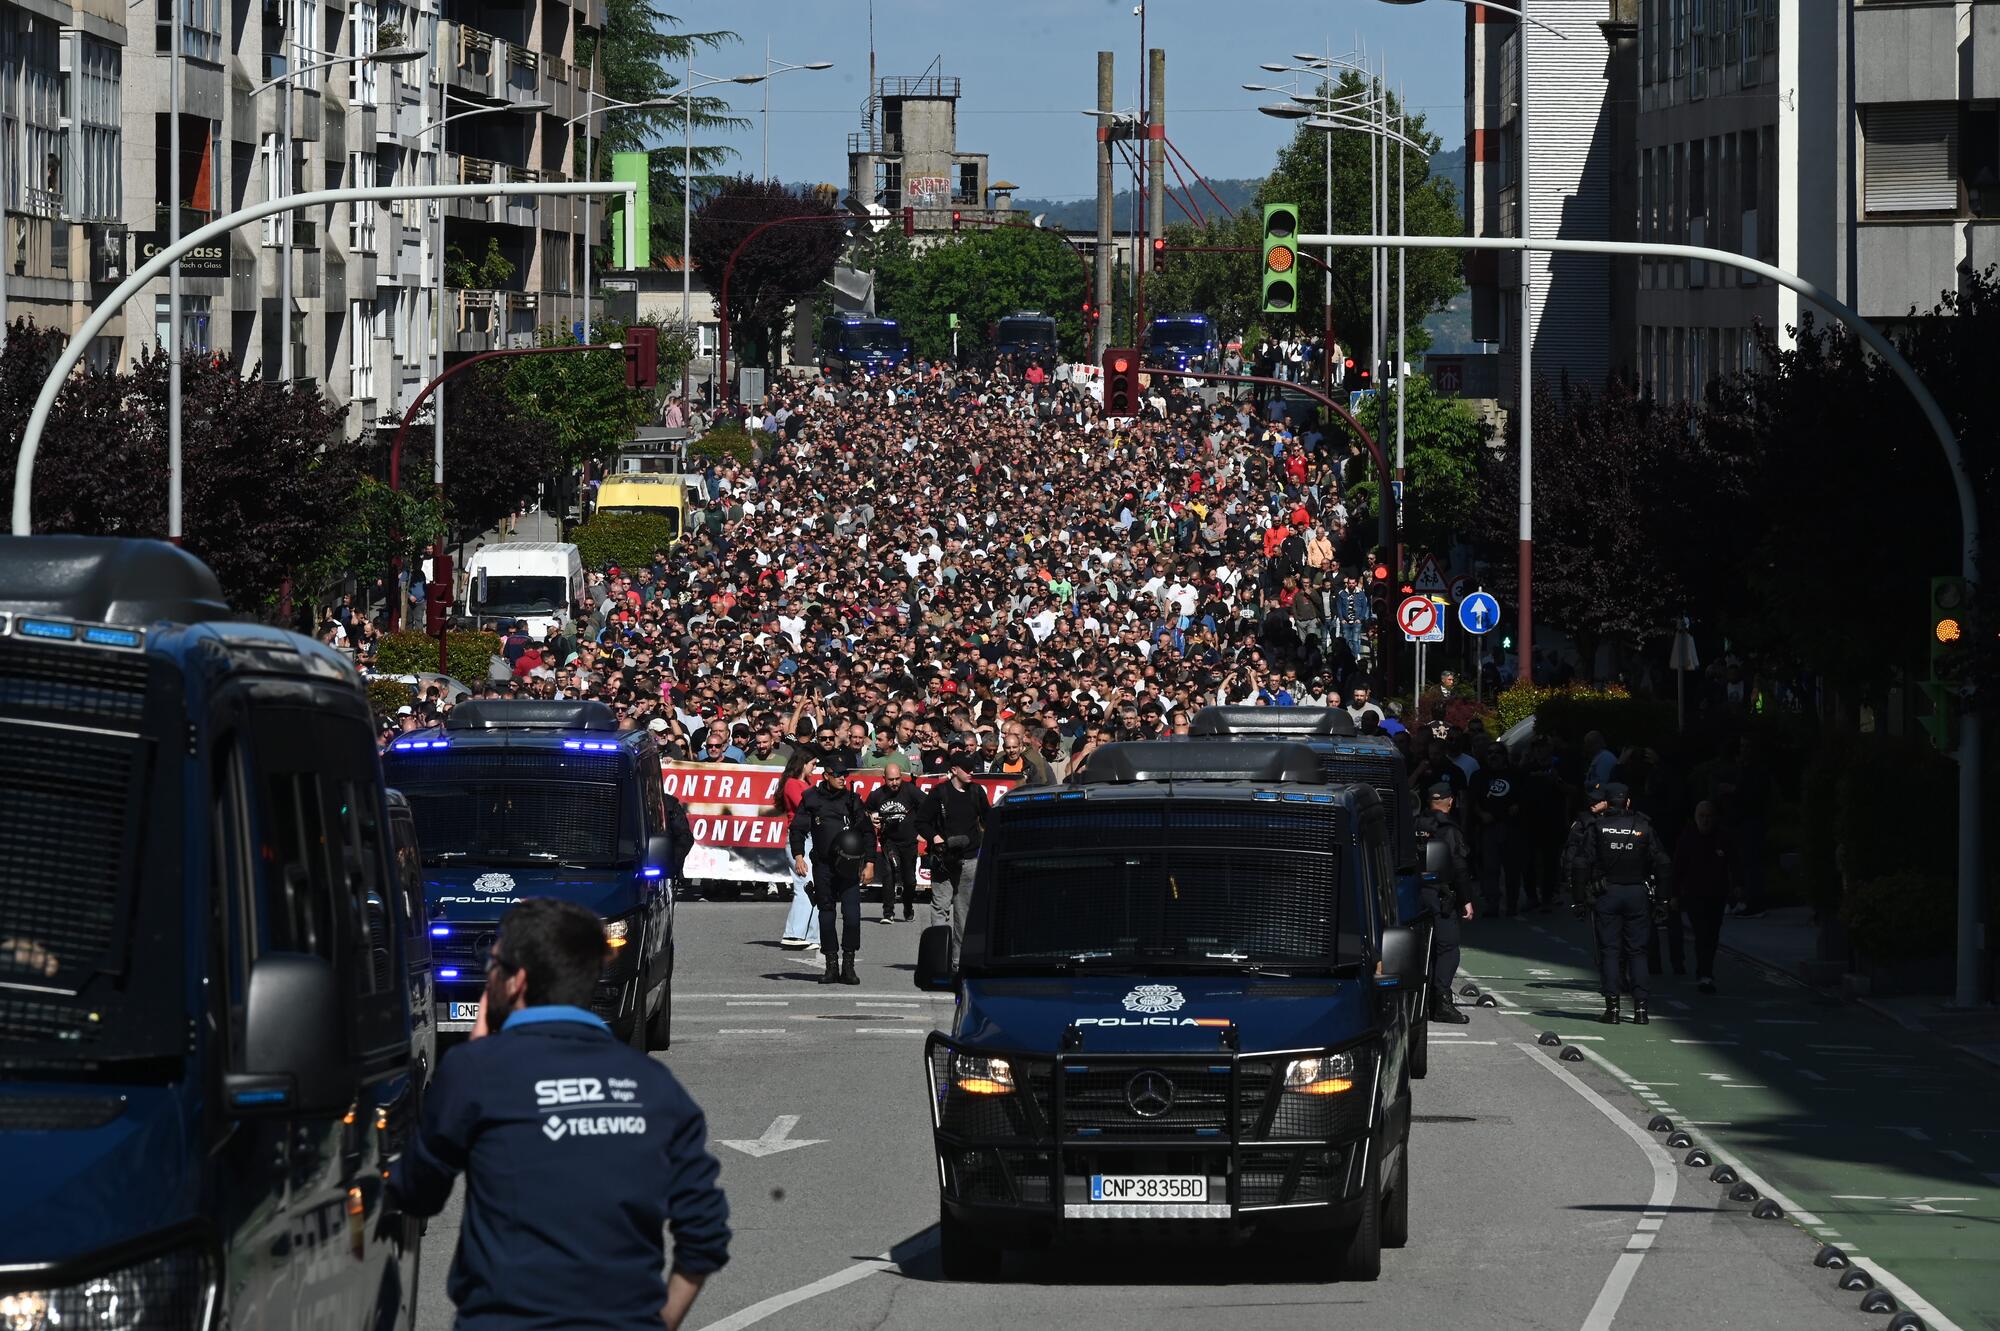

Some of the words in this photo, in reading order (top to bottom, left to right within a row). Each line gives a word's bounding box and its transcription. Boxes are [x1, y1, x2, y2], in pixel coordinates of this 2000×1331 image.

[664, 774, 752, 799] ONTRA
[692, 818, 784, 844] ONVEN
[440, 896, 523, 904] POLICIA
[458, 1004, 481, 1018] CNP
[1075, 1017, 1199, 1027] POLICIA
[534, 1077, 606, 1105] SER
[566, 1115, 647, 1136] TELEVIGO
[1102, 1178, 1203, 1198] CNP3835BD
